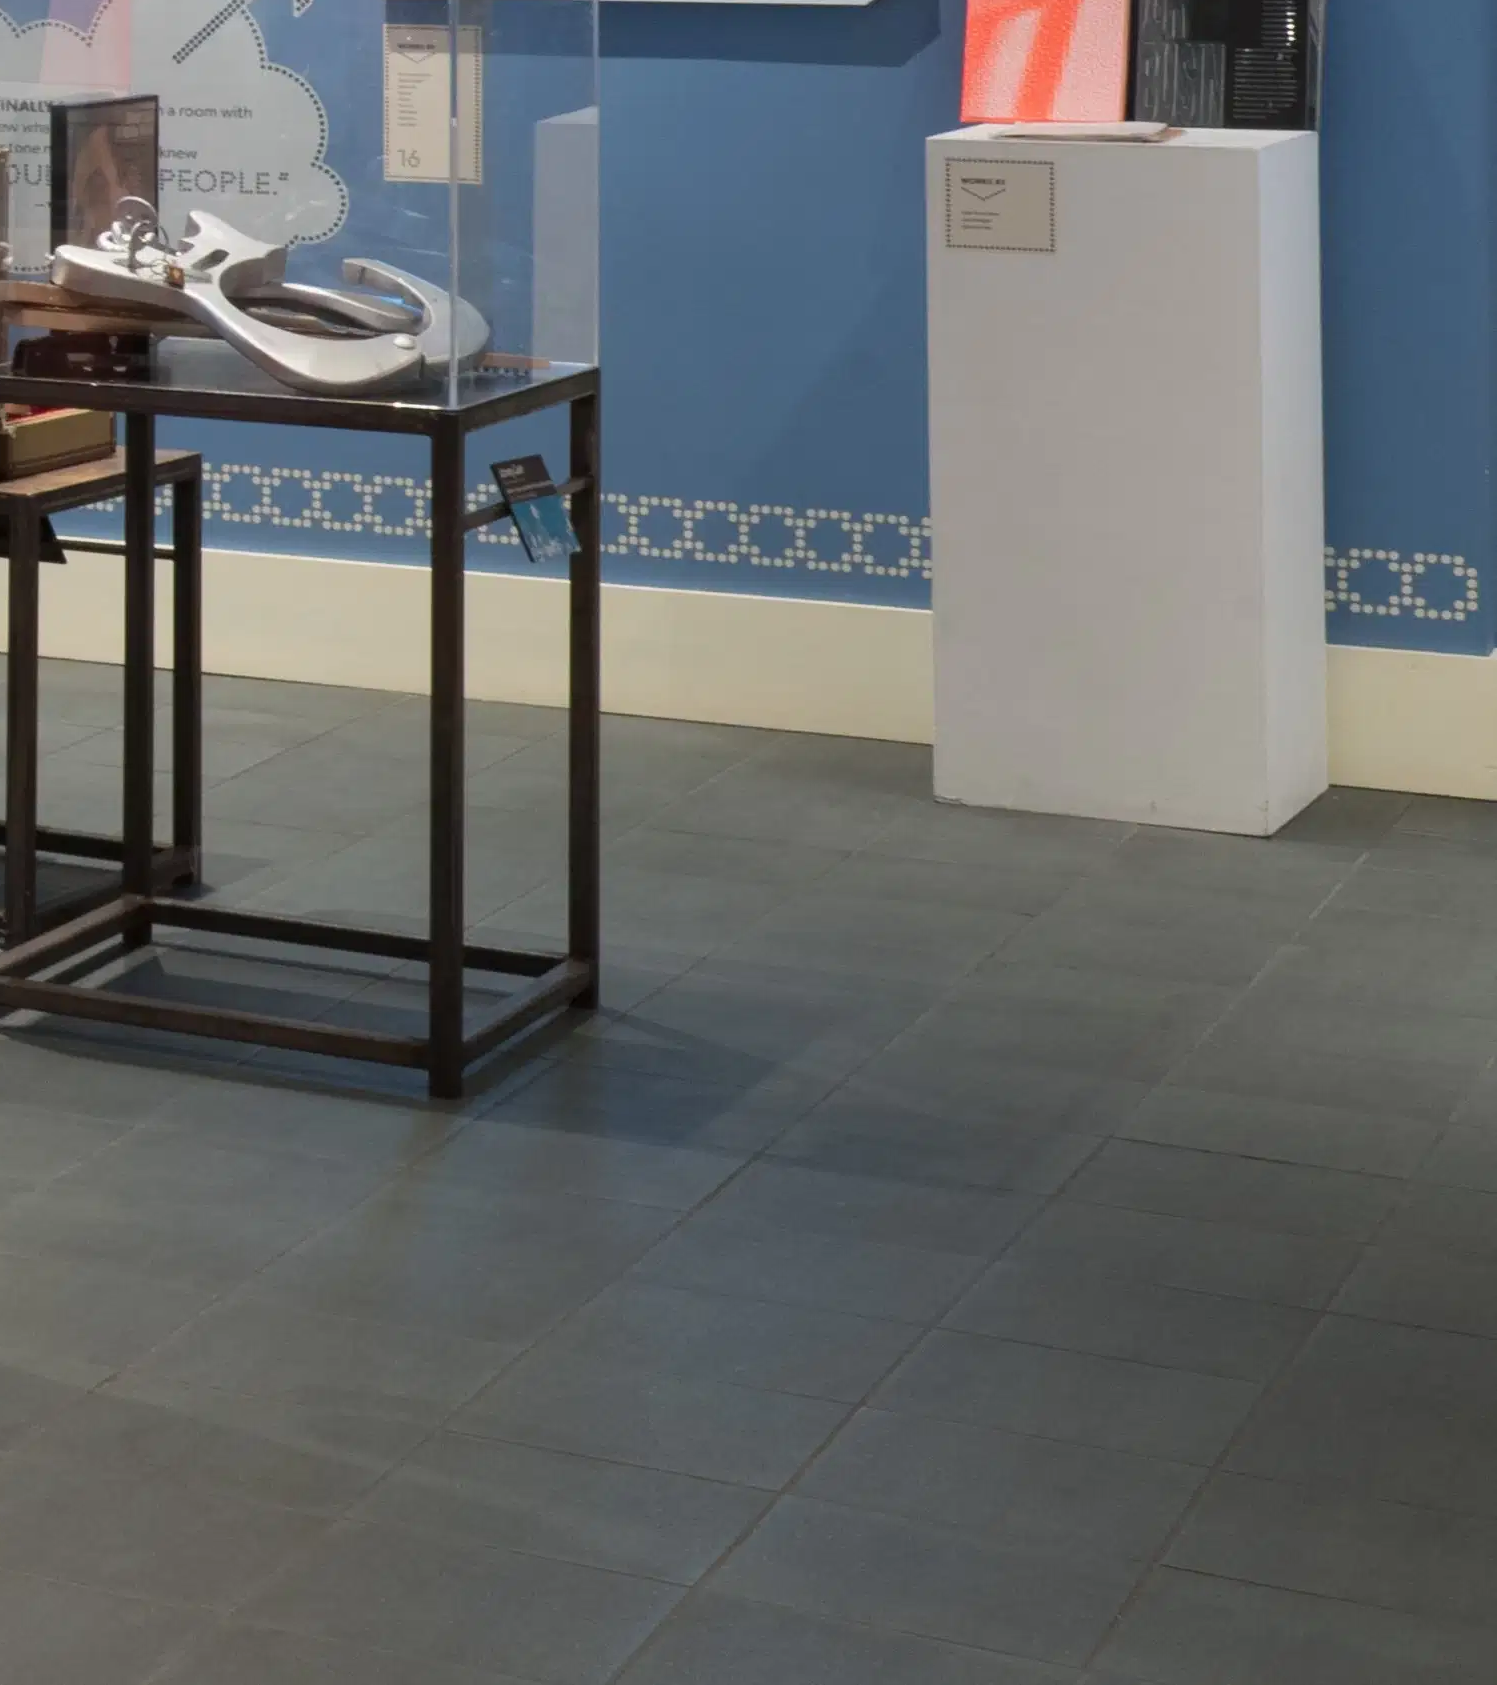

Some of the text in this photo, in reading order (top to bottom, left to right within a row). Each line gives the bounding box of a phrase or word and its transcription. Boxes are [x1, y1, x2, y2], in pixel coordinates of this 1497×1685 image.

[178, 107, 217, 119] room
[220, 105, 254, 119] with
[22, 120, 51, 134] wha
[396, 147, 421, 169] 16
